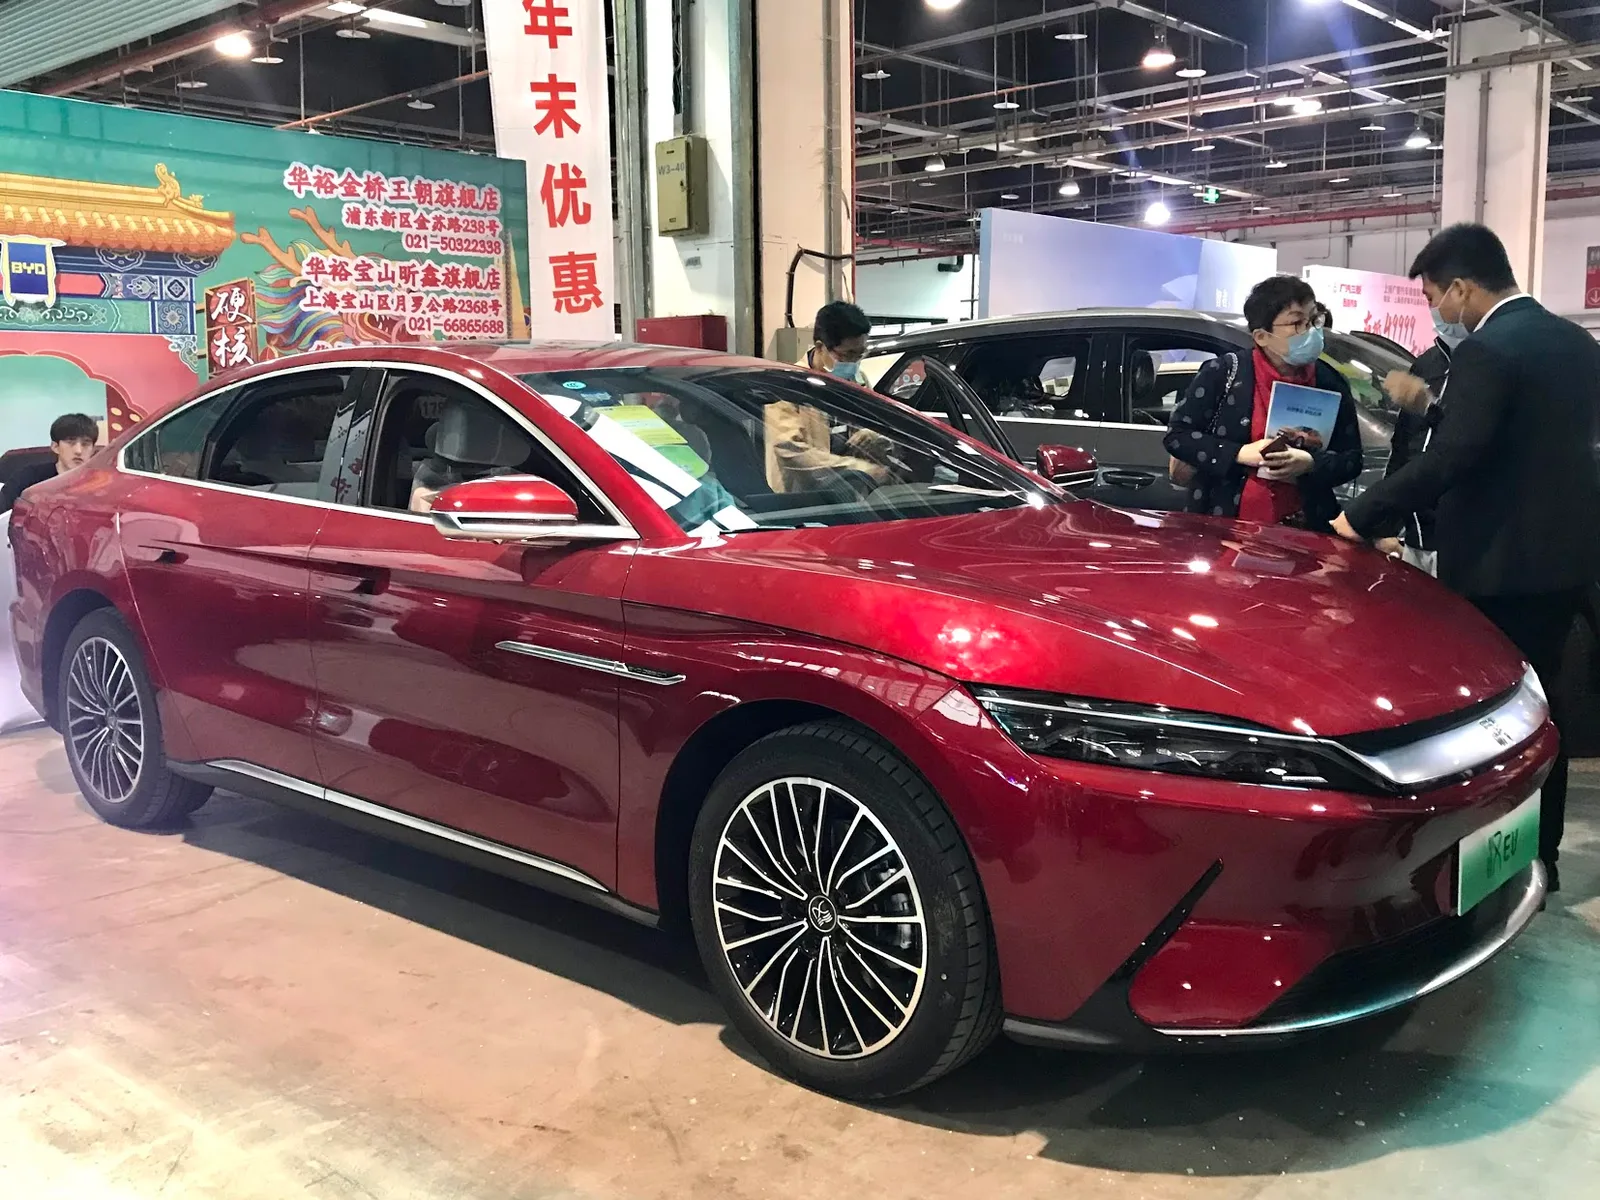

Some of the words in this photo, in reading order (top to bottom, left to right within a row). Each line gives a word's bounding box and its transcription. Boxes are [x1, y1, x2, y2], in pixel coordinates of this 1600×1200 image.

[521, 0, 604, 314] 年末优惠
[658, 162, 685, 175] W3-40
[287, 166, 499, 211] 华裕金桥王朝旗舰店
[345, 206, 500, 237] 浦东新区金苏路238号
[11, 262, 46, 275] BYD
[306, 256, 501, 290] 华裕宝山昕鑫旗舰店
[211, 287, 255, 368] 硬核
[408, 317, 504, 334] 021-66865688
